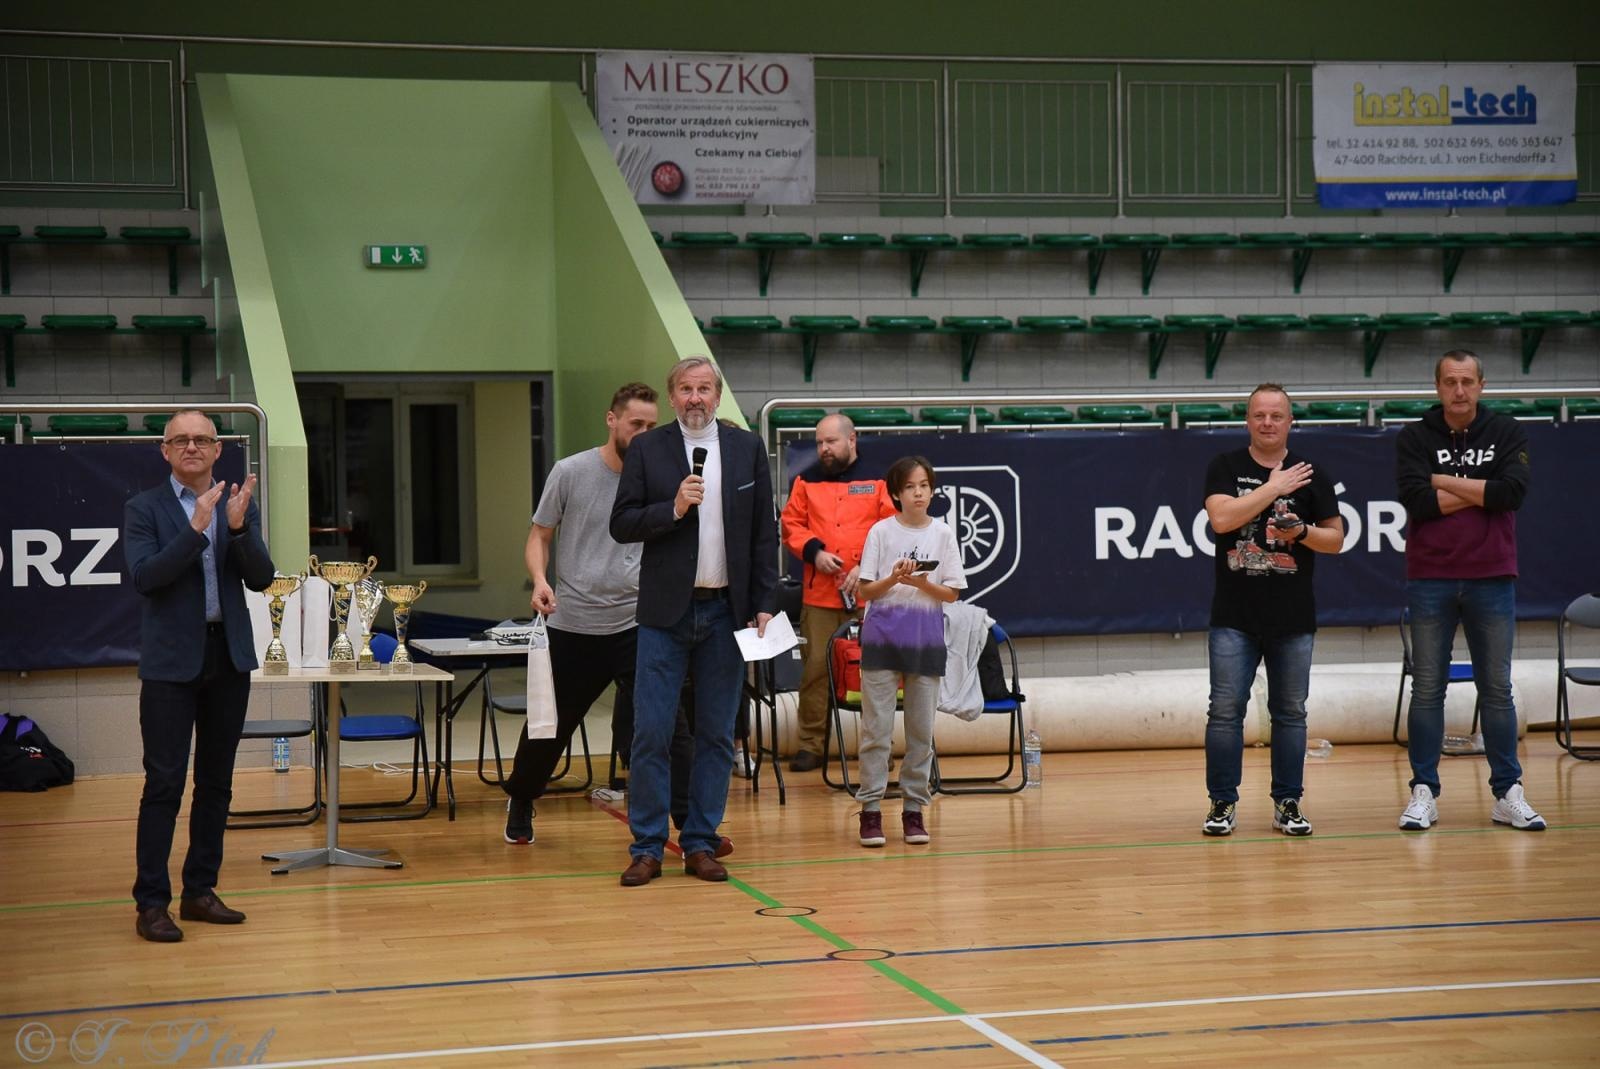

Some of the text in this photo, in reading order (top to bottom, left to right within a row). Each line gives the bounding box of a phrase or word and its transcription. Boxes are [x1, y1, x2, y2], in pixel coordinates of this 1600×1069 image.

[624, 62, 789, 95] MIESZKO
[1353, 82, 1537, 126] instal-tech
[627, 115, 810, 128] Operator urządzeń cukierniczych
[627, 128, 759, 140] Pracownik produkcyjny
[1327, 138, 1342, 149] tel.
[1346, 138, 1359, 149] 32
[1362, 138, 1384, 148] 414
[1385, 138, 1399, 148] 92
[1424, 138, 1444, 148] 502
[1446, 137, 1467, 149] 632
[1498, 137, 1519, 147] 606
[1521, 137, 1540, 148] 363
[1543, 136, 1563, 147] 647
[694, 148, 802, 159] Czekamy na Ciebie!
[1334, 155, 1376, 166] 47-400
[1430, 154, 1443, 165] ul.
[1456, 156, 1477, 164] von
[1479, 152, 1546, 164] Eichendorffa
[1550, 152, 1556, 163] 2
[1385, 187, 1507, 203] www.instal-tech.pl
[1436, 444, 1496, 466] PRIS
[0, 528, 121, 587] RZ
